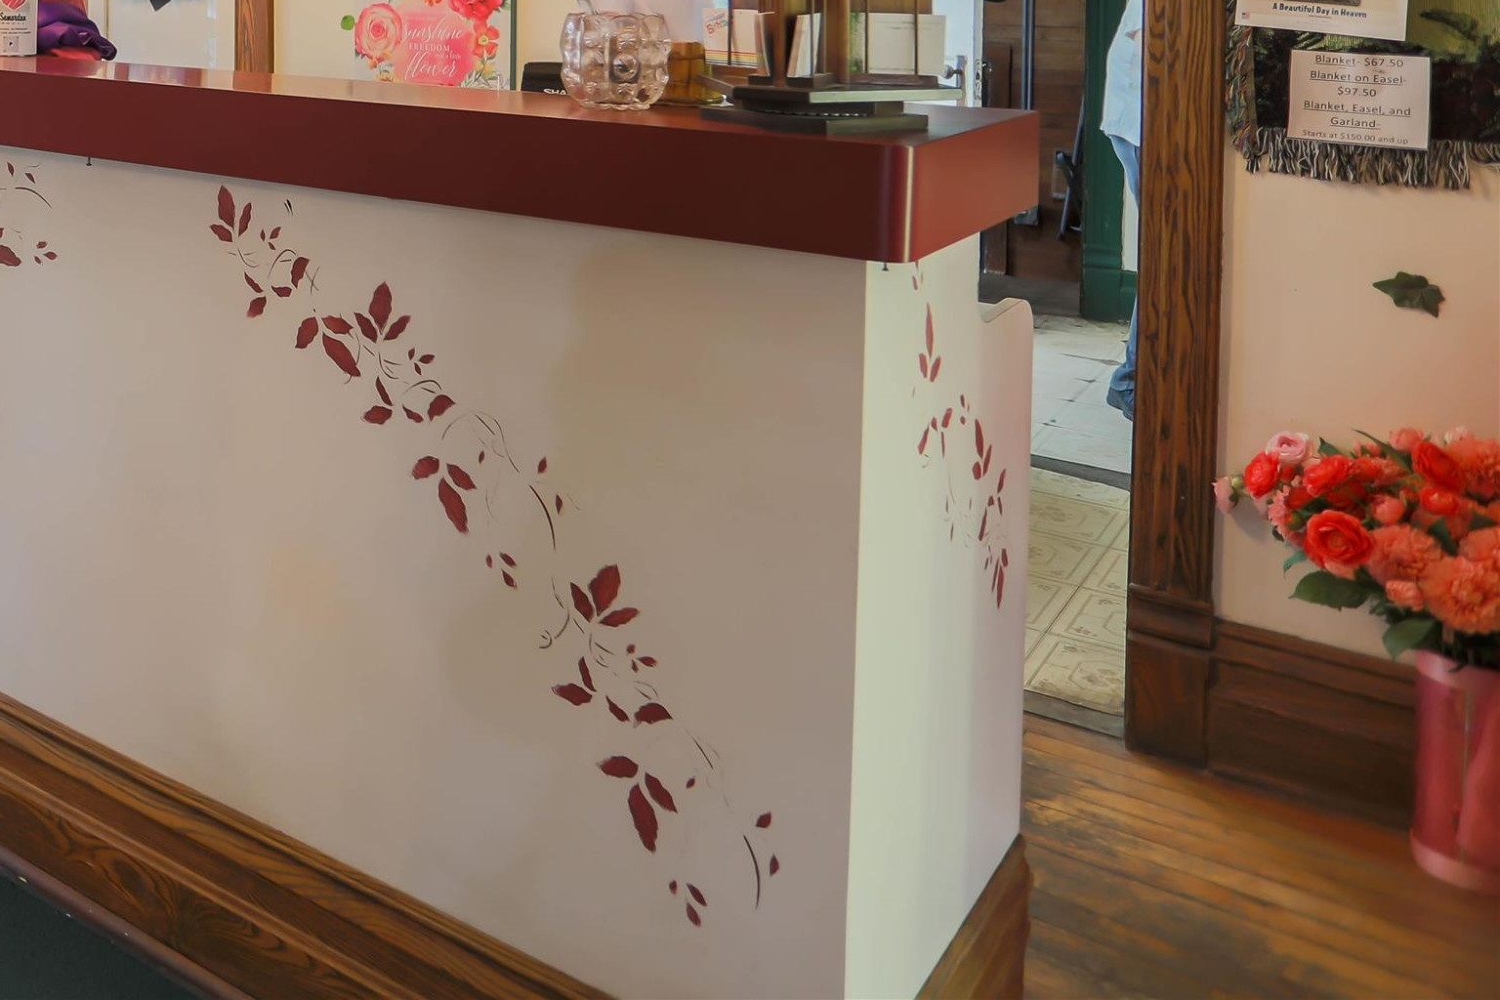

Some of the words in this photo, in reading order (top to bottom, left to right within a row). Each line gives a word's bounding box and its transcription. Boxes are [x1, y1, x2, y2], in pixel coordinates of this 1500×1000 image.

[1279, 3, 1314, 13] Beautiful
[1316, 7, 1330, 15] Day
[1341, 8, 1367, 18] Heaven
[405, 51, 456, 80] flower
[1364, 57, 1403, 68] $67.50
[1310, 71, 1351, 81] Blanket
[1338, 87, 1376, 97] $97.50
[1304, 100, 1348, 112] Blanket,
[1352, 104, 1385, 115] Easel,
[1389, 107, 1411, 116] and
[1330, 117, 1380, 128] Garland-
[1302, 130, 1326, 138] Starts
[1340, 134, 1375, 142] $150.00
